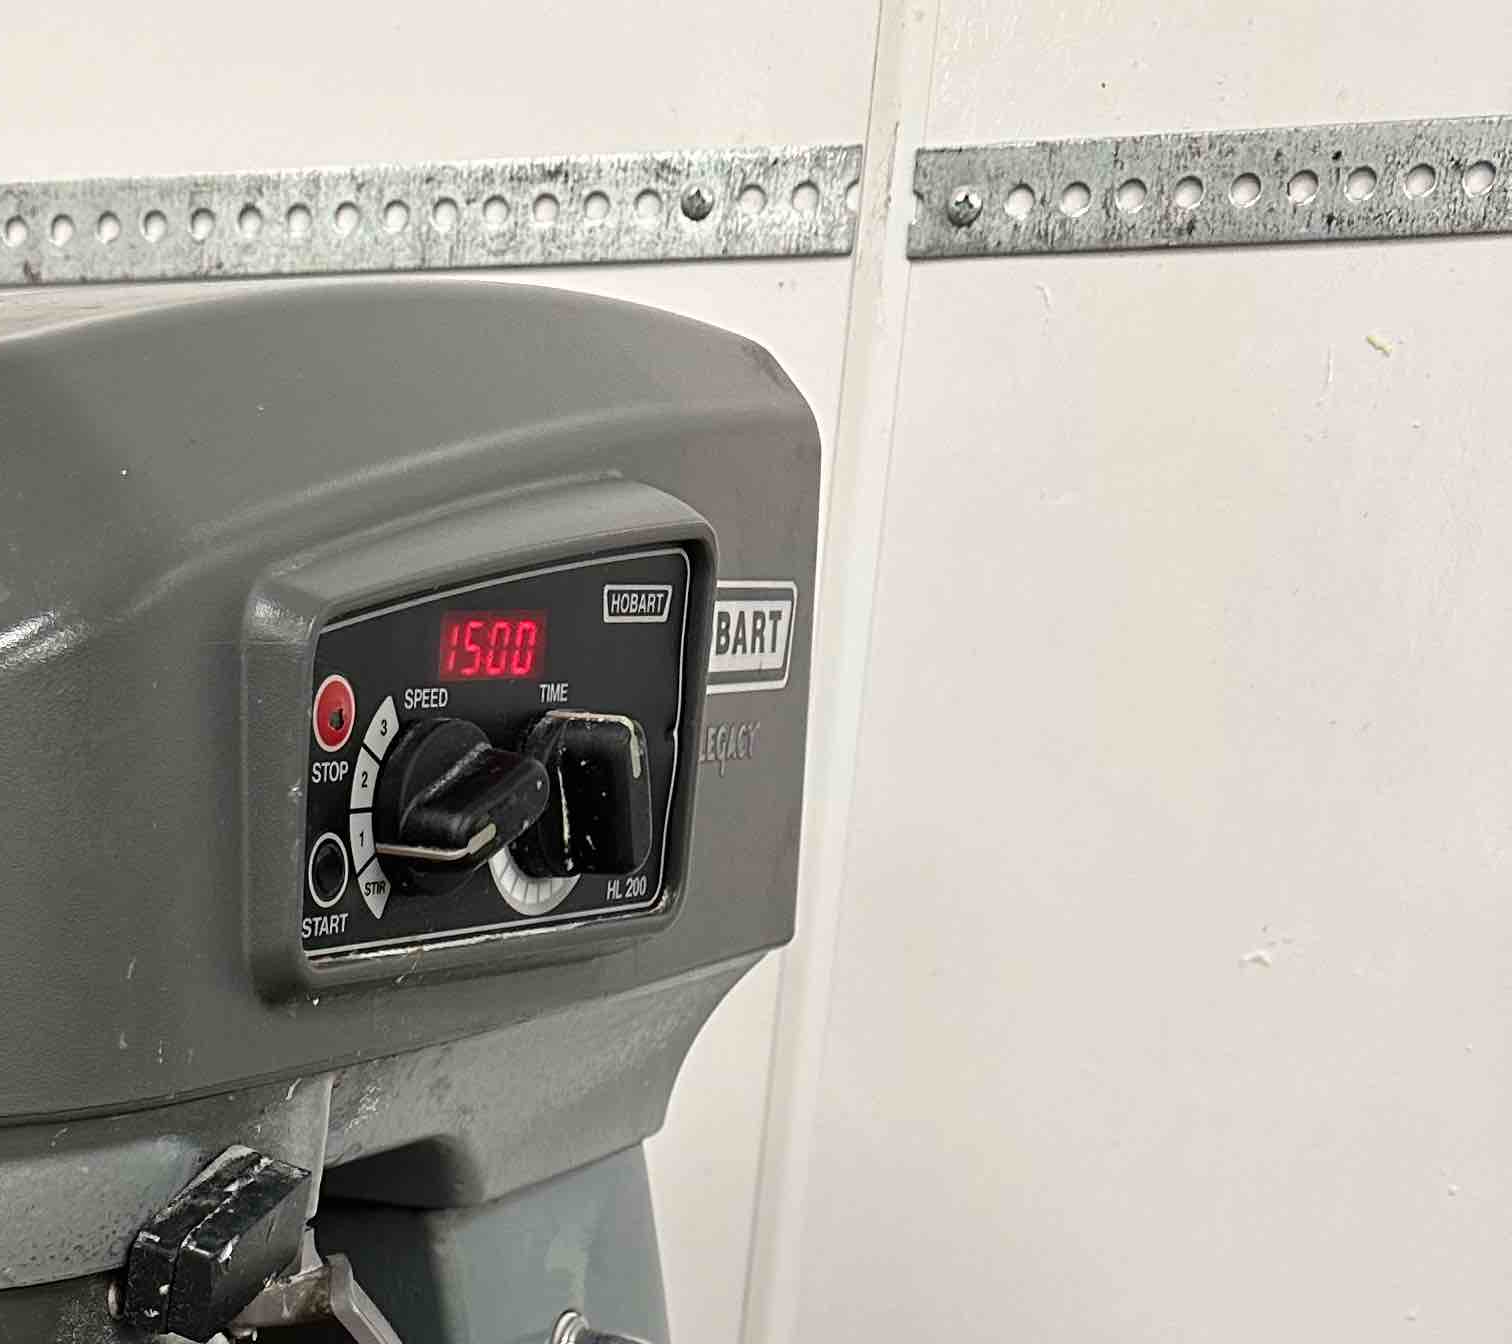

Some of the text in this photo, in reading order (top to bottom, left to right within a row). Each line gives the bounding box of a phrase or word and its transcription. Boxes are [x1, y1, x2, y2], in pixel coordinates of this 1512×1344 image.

[611, 593, 665, 614] HOBART
[715, 610, 782, 655] BART
[404, 688, 449, 710] SPEED
[539, 683, 569, 703] TIME
[380, 719, 388, 736] 3
[312, 761, 349, 783] STOP
[361, 771, 368, 788] 2
[359, 831, 365, 847] 1
[364, 881, 386, 897] STIR
[606, 875, 648, 900] HL 200
[302, 913, 349, 939] START
